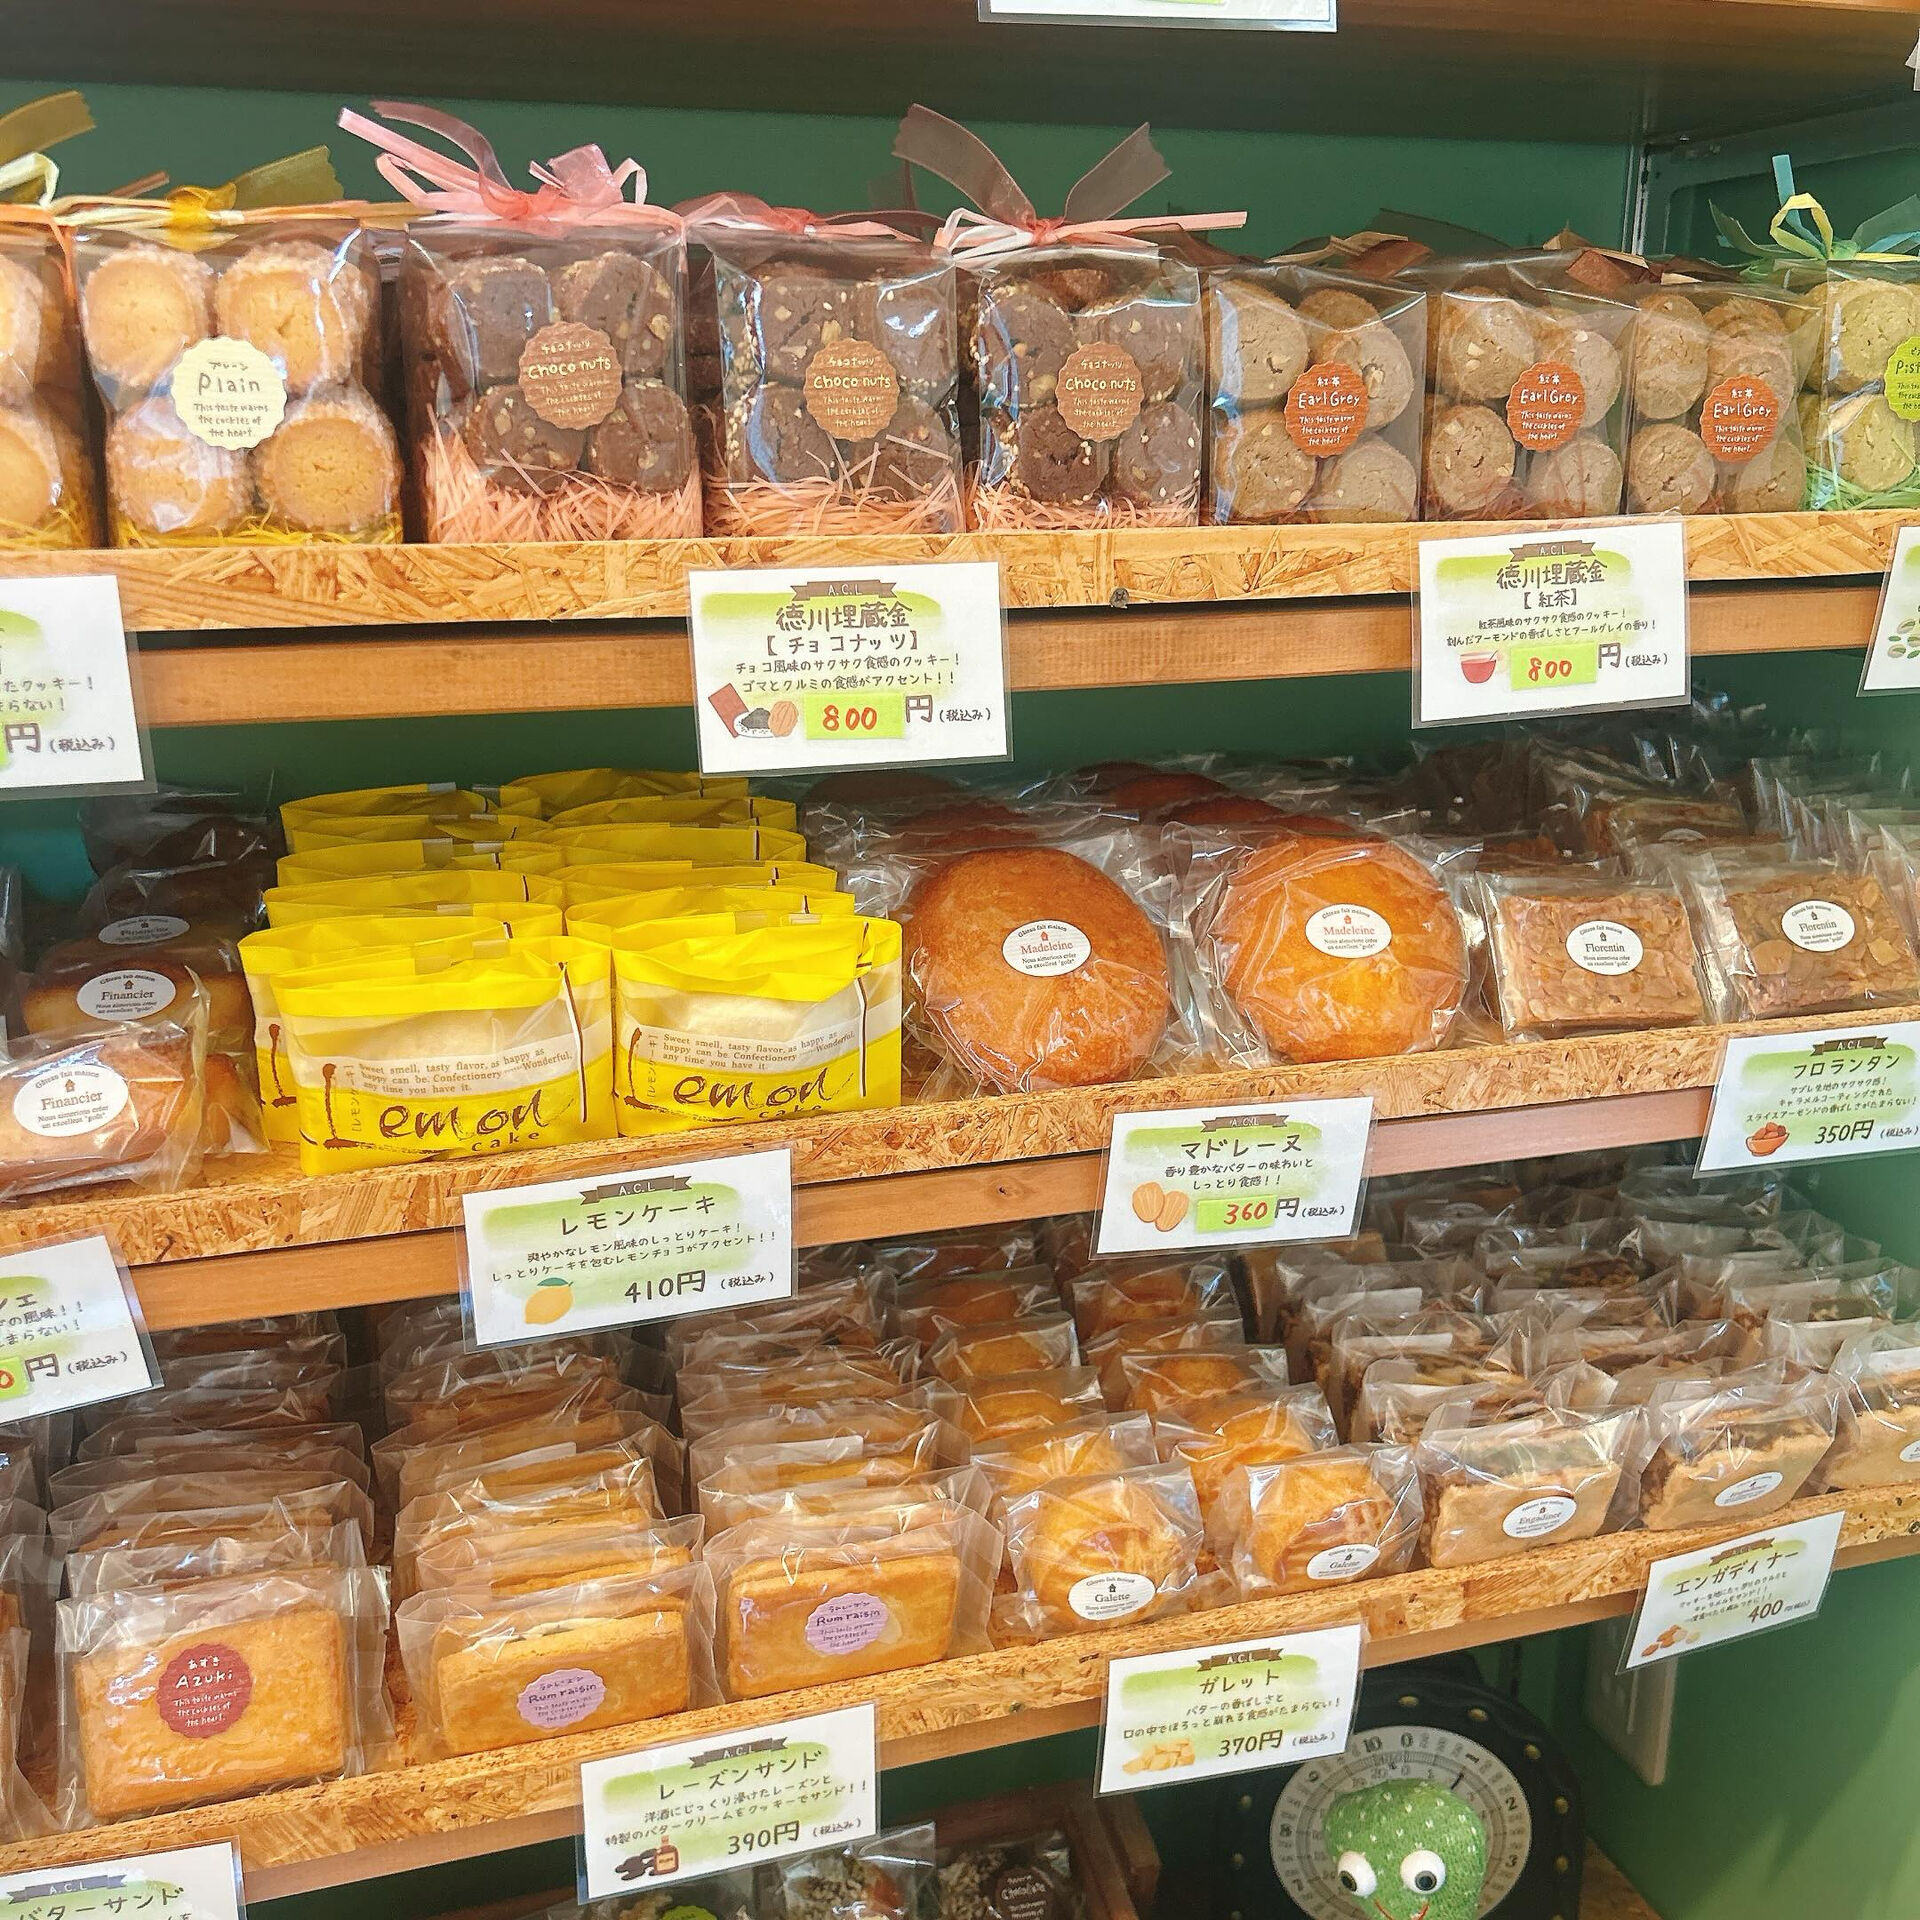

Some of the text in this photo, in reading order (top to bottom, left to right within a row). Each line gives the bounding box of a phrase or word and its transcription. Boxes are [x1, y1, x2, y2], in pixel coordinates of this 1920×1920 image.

[580, 356, 612, 370] nuts
[199, 372, 260, 396] Plain
[862, 374, 891, 388] nuts
[1110, 378, 1136, 392] nuts
[1298, 391, 1360, 409] Earl Grey
[1520, 388, 1579, 405] Earl Grey
[194, 403, 269, 413] This taste warms
[1713, 402, 1772, 419] Earl Grey
[198, 415, 213, 425] the
[252, 416, 262, 426] of
[209, 428, 224, 438] the
[1496, 559, 1608, 590] 徳川埋蔵金
[1522, 588, 1578, 610] 【紅茶】
[775, 600, 913, 632] 徳川埋蔵金
[1478, 608, 1627, 631] 紅茶風味のサクサク食感のクッキー！
[766, 632, 919, 657] 【チョコナッツ】
[735, 653, 960, 675] チョコ風味のサクサク食感のクッキー！
[742, 671, 955, 694] ゴマとクルミの食感がアクセント！！
[4, 723, 41, 754] 円
[1323, 926, 1376, 935] Madeleine
[1020, 941, 1074, 955] Madeleine
[101, 990, 154, 1001] Financier
[663, 1042, 690, 1056] happy
[696, 1048, 712, 1057] can
[733, 1052, 797, 1062] Confectionery
[728, 1042, 751, 1052] tasty
[788, 1045, 797, 1053] as
[801, 1035, 825, 1050] happy
[426, 1064, 450, 1074] tasty
[491, 1061, 500, 1069] as
[503, 1052, 532, 1066] happy
[663, 1052, 678, 1062] any
[684, 1055, 704, 1064] time
[710, 1060, 726, 1068] you
[732, 1061, 753, 1069] have
[1793, 1055, 1900, 1080] フロランタン
[361, 1071, 386, 1083] happy
[392, 1076, 410, 1084] can
[433, 1071, 502, 1083] Confectionery
[364, 1081, 377, 1092] any
[383, 1084, 402, 1092] time
[409, 1086, 426, 1095] you
[433, 1084, 456, 1093] have
[40, 1091, 103, 1111] Financier
[758, 1104, 823, 1120] cake
[472, 1132, 540, 1152] cake
[1814, 1119, 1875, 1145] 350円
[1181, 1134, 1302, 1160] マドレーヌ
[1165, 1157, 1313, 1178] 香り豊かなバターの味わいと
[1192, 1175, 1281, 1191] しっとり食感！！
[561, 1195, 716, 1236] レモンケーキ
[527, 1221, 743, 1263] 爽やかなレモン風味のしっとりケーキ！
[624, 1269, 706, 1304] 410円
[1673, 1551, 1799, 1596] エンガディナー
[1095, 1593, 1131, 1602] Galette
[816, 1609, 880, 1626] Rum raisin
[175, 1670, 233, 1689] Azuki
[1200, 1668, 1279, 1695] ガレット
[529, 1684, 597, 1704] Rum raisin
[1186, 1693, 1284, 1716] バターの香ばしさと
[1218, 1729, 1283, 1758] 370円
[659, 1750, 822, 1800] レーズンサンド
[728, 1820, 800, 1855] 390円
